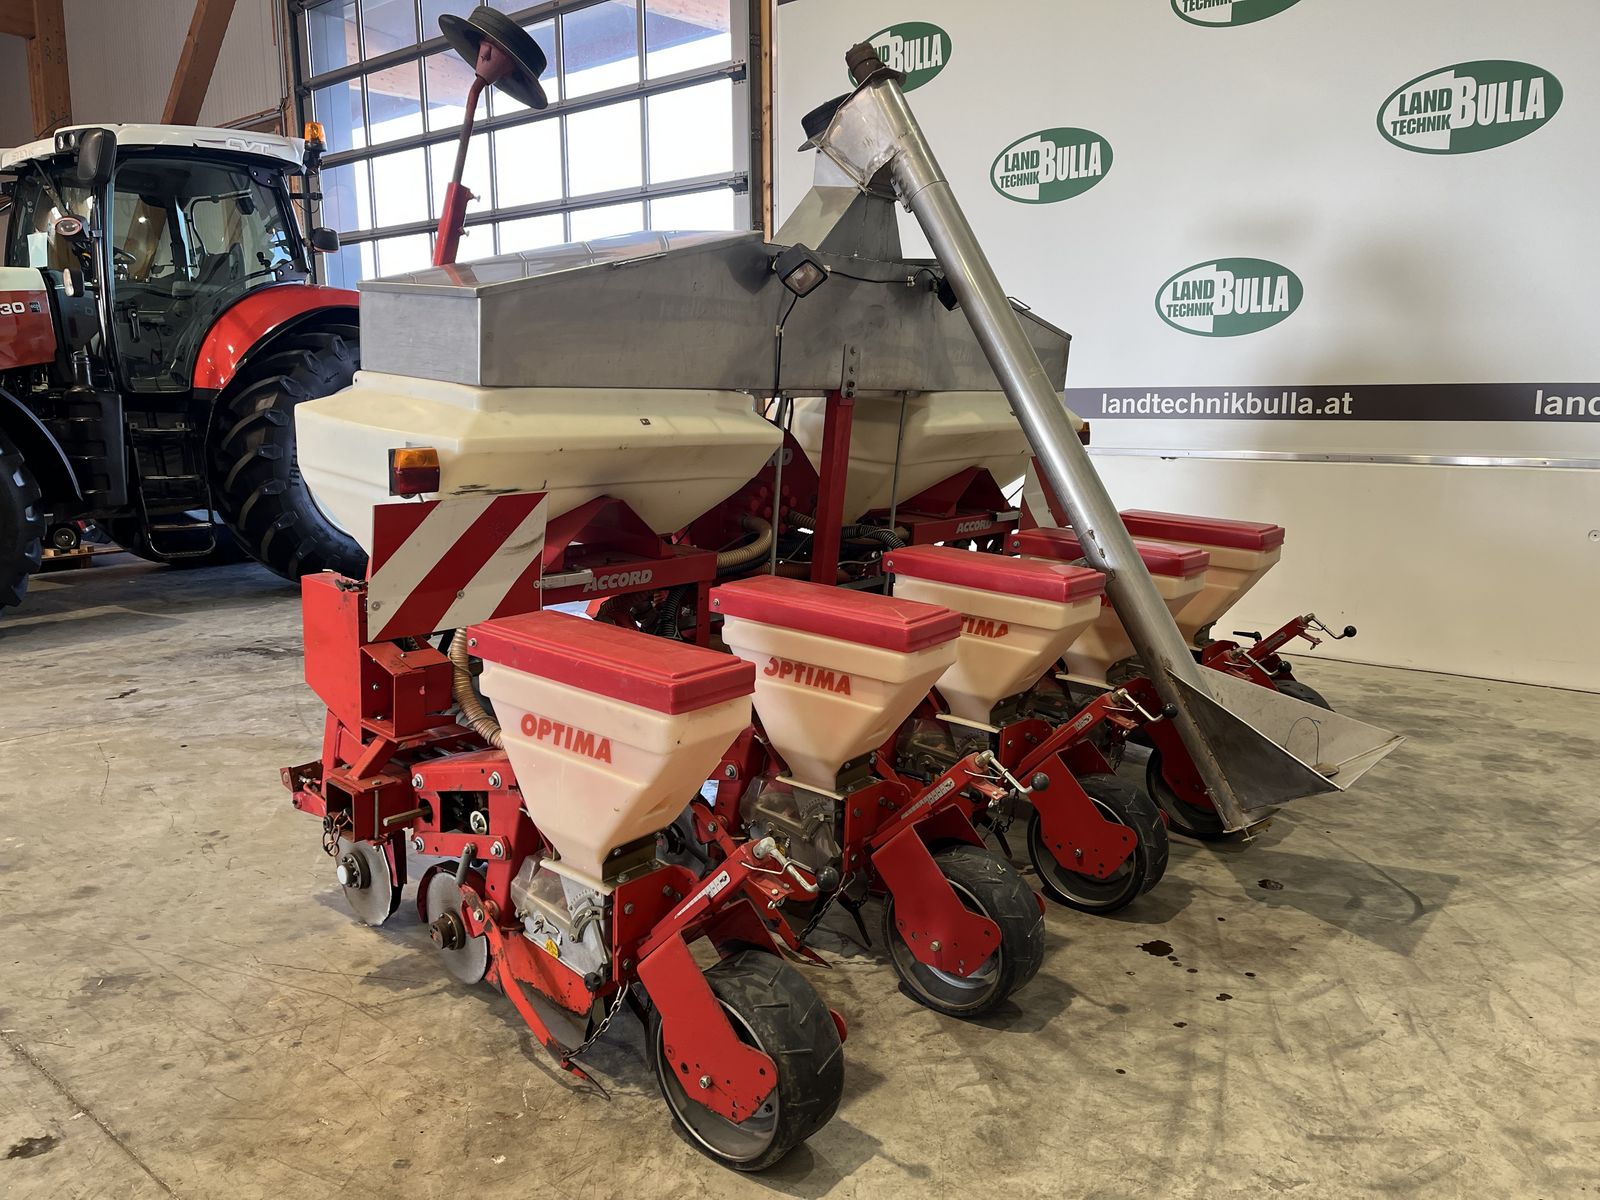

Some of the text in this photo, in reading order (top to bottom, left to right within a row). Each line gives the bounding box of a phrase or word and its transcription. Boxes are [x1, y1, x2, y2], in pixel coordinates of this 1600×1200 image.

[889, 34, 943, 73] BULLA
[1399, 88, 1453, 117] LAND
[1451, 77, 1545, 130] BULLA
[1391, 114, 1452, 137] TECHNIK
[1004, 150, 1040, 172] LAND
[1039, 141, 1102, 184] BULLA
[1000, 171, 1040, 189] TECHNIK
[1172, 280, 1215, 301] LAND
[1213, 270, 1290, 316] BULLA
[1166, 302, 1214, 318] TECHNIK
[1101, 392, 1353, 415] landtechnikbulla.at
[955, 520, 992, 534] ACCORD
[583, 569, 653, 593] ACCORD
[960, 616, 1009, 638] TIMA
[520, 713, 612, 764] OPTIMA
